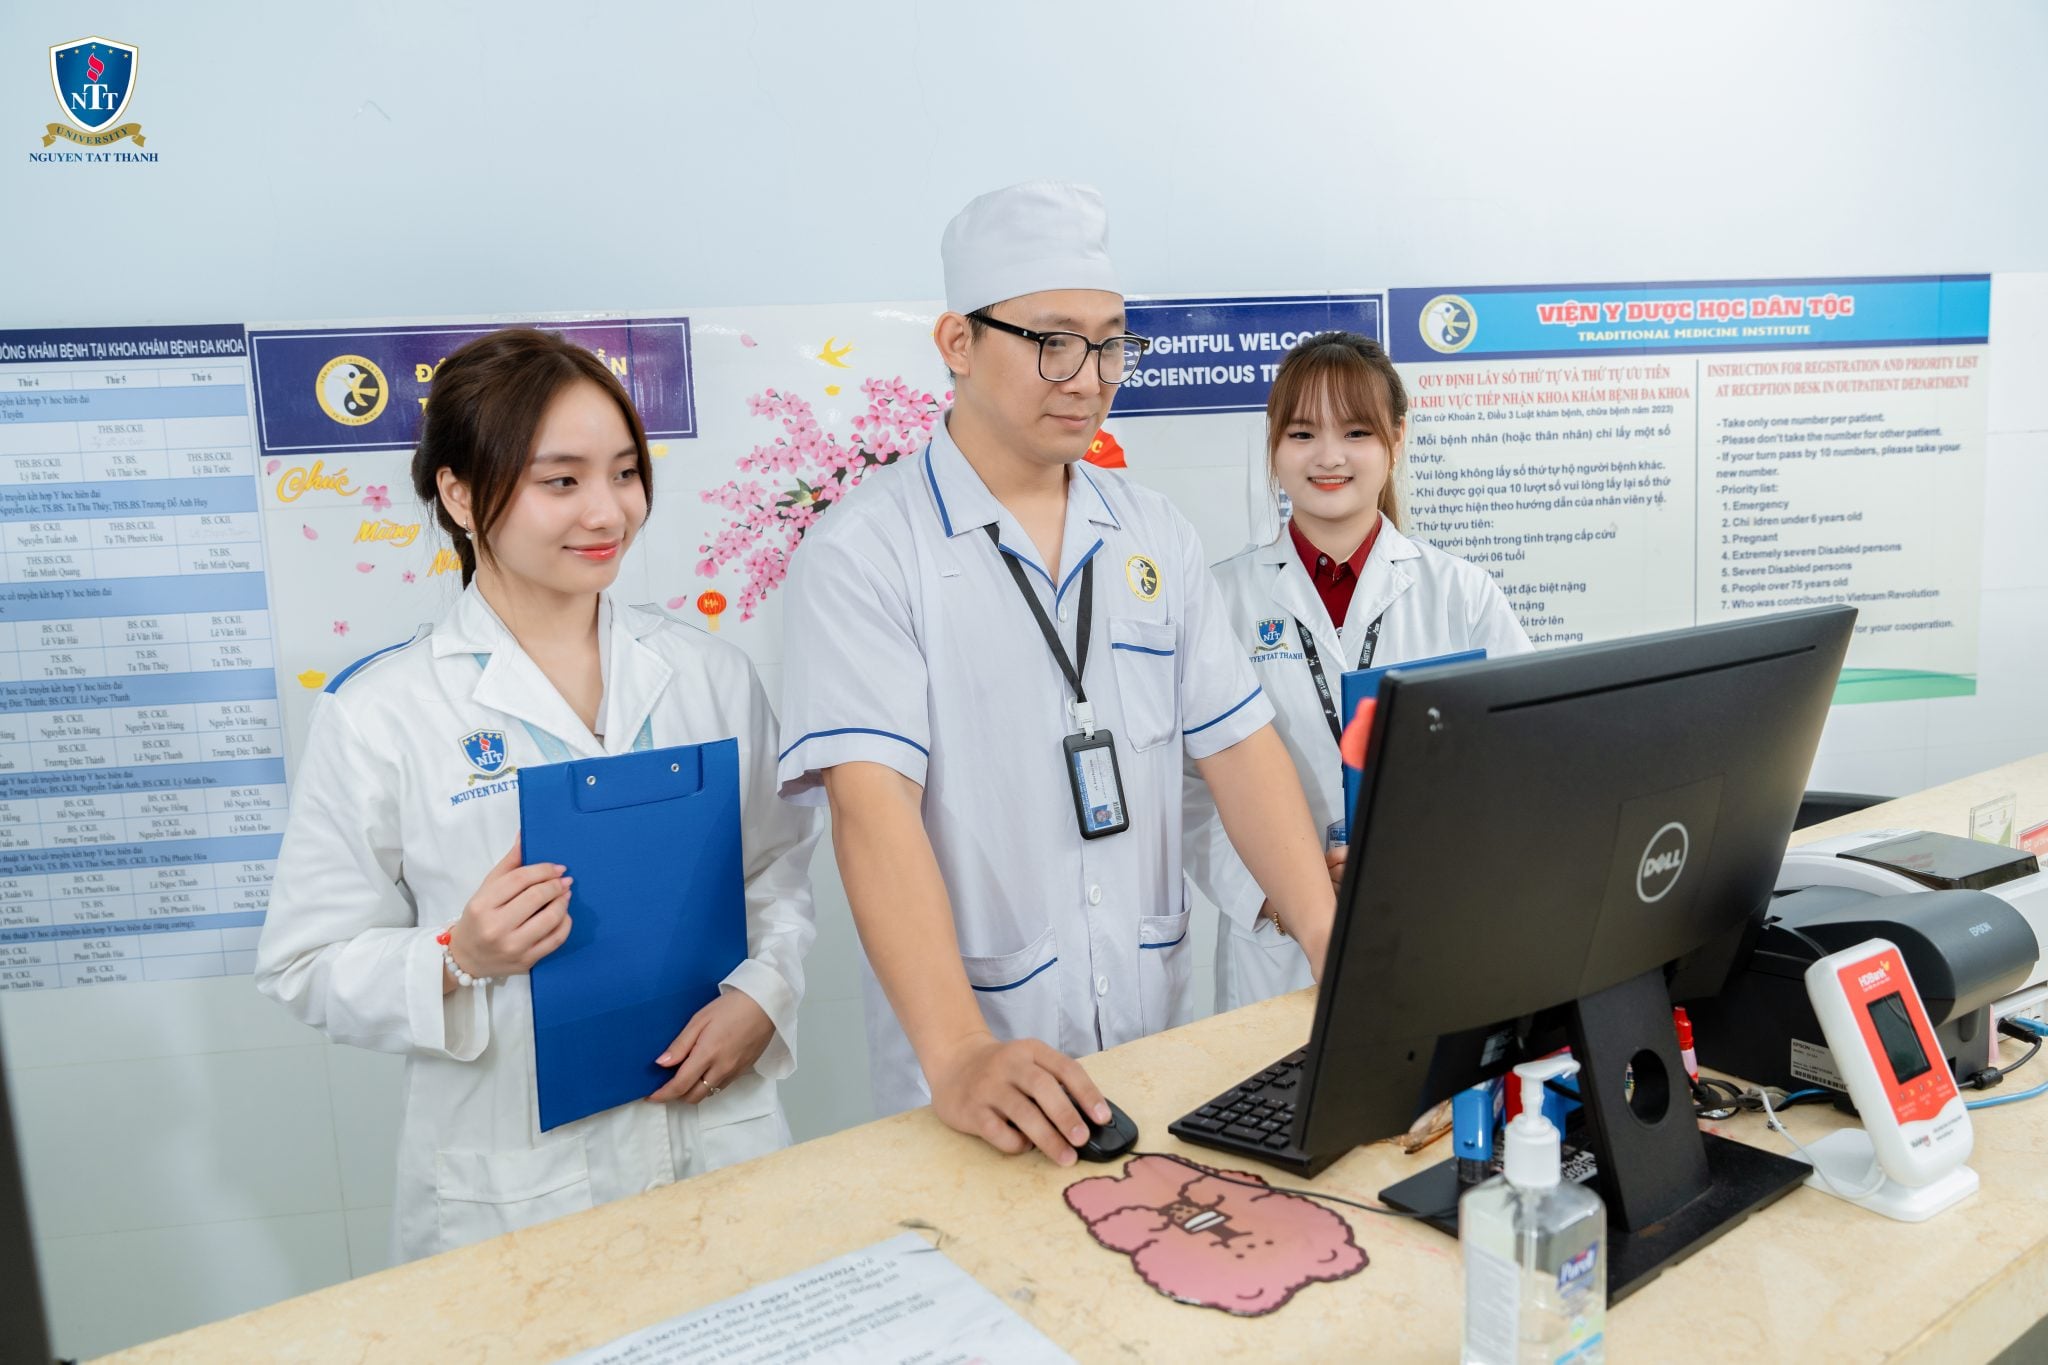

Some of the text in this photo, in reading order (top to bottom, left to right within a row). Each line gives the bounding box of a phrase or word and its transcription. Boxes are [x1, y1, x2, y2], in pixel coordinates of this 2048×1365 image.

[1538, 293, 1853, 326] VIỆN Y DƯỢC HỌC DÂN TỘC
[1577, 325, 1810, 342] TRADITIONAL MEDICINE INSTITUTE
[1418, 364, 1670, 390] QUY ĐỊNH LẤY SỐ THỨ TỰ VÀ THỨ TỰ ƯU TIÊN
[1708, 356, 1978, 377] INSTRUCTION FOR REGISTRATION AND PRIORITY LIST
[1716, 375, 1970, 397] AT RECEPTION DESK IN OUTPATIENT DEPARTMENT
[1420, 395, 1445, 408] KHU
[1448, 393, 1472, 409] VỰC
[1475, 390, 1501, 406] TIẾP
[1502, 391, 1534, 407] NHẬN
[1537, 391, 1570, 404] KHOA
[1572, 386, 1606, 402] KHÁM
[1608, 387, 1638, 404] BỆNH
[1641, 388, 1656, 400] ĐA
[1658, 387, 1690, 399] KHOA
[1722, 418, 1746, 428] Take
[1746, 417, 1769, 428] only
[1770, 418, 1790, 426] one
[1790, 416, 1830, 425] number
[1830, 416, 1848, 426] per
[1417, 433, 1436, 446] Mỗi
[1440, 434, 1467, 446] bệnh
[1472, 433, 1498, 444] nhân
[1502, 432, 1531, 444] (hoặc
[1535, 430, 1558, 441] thân
[1563, 430, 1592, 440] nhân)
[1616, 426, 1631, 439] lấy
[1634, 426, 1654, 438] một
[1658, 424, 1671, 436] số
[1410, 453, 1445, 464] thứ tự.
[276, 459, 360, 503] Chúc
[1415, 460, 1665, 481] Vui lòng không lấy số thứ tự hộ người bệnh khác.
[1416, 475, 1671, 498] Khi được gọi qua 10 lượt số vui lòng lấy lại số thứ
[1722, 500, 1789, 512] 1. Emergency
[354, 519, 421, 547] Mừng
[1429, 528, 1616, 548] Người bệnh trong tình trạng cấp cứu
[1722, 533, 1778, 545] 3. Pregnant
[1722, 563, 1852, 577] 5. Severe Disabled persons
[1870, 624, 1892, 634] your
[1894, 620, 1954, 632] cooperation.
[1266, 652, 1279, 660] TAT
[1279, 652, 1303, 660] THANH
[450, 786, 490, 806] NGUYEN
[490, 781, 509, 794] TAT
[1643, 849, 1680, 878] DELL
[1969, 922, 1992, 936] EPSON
